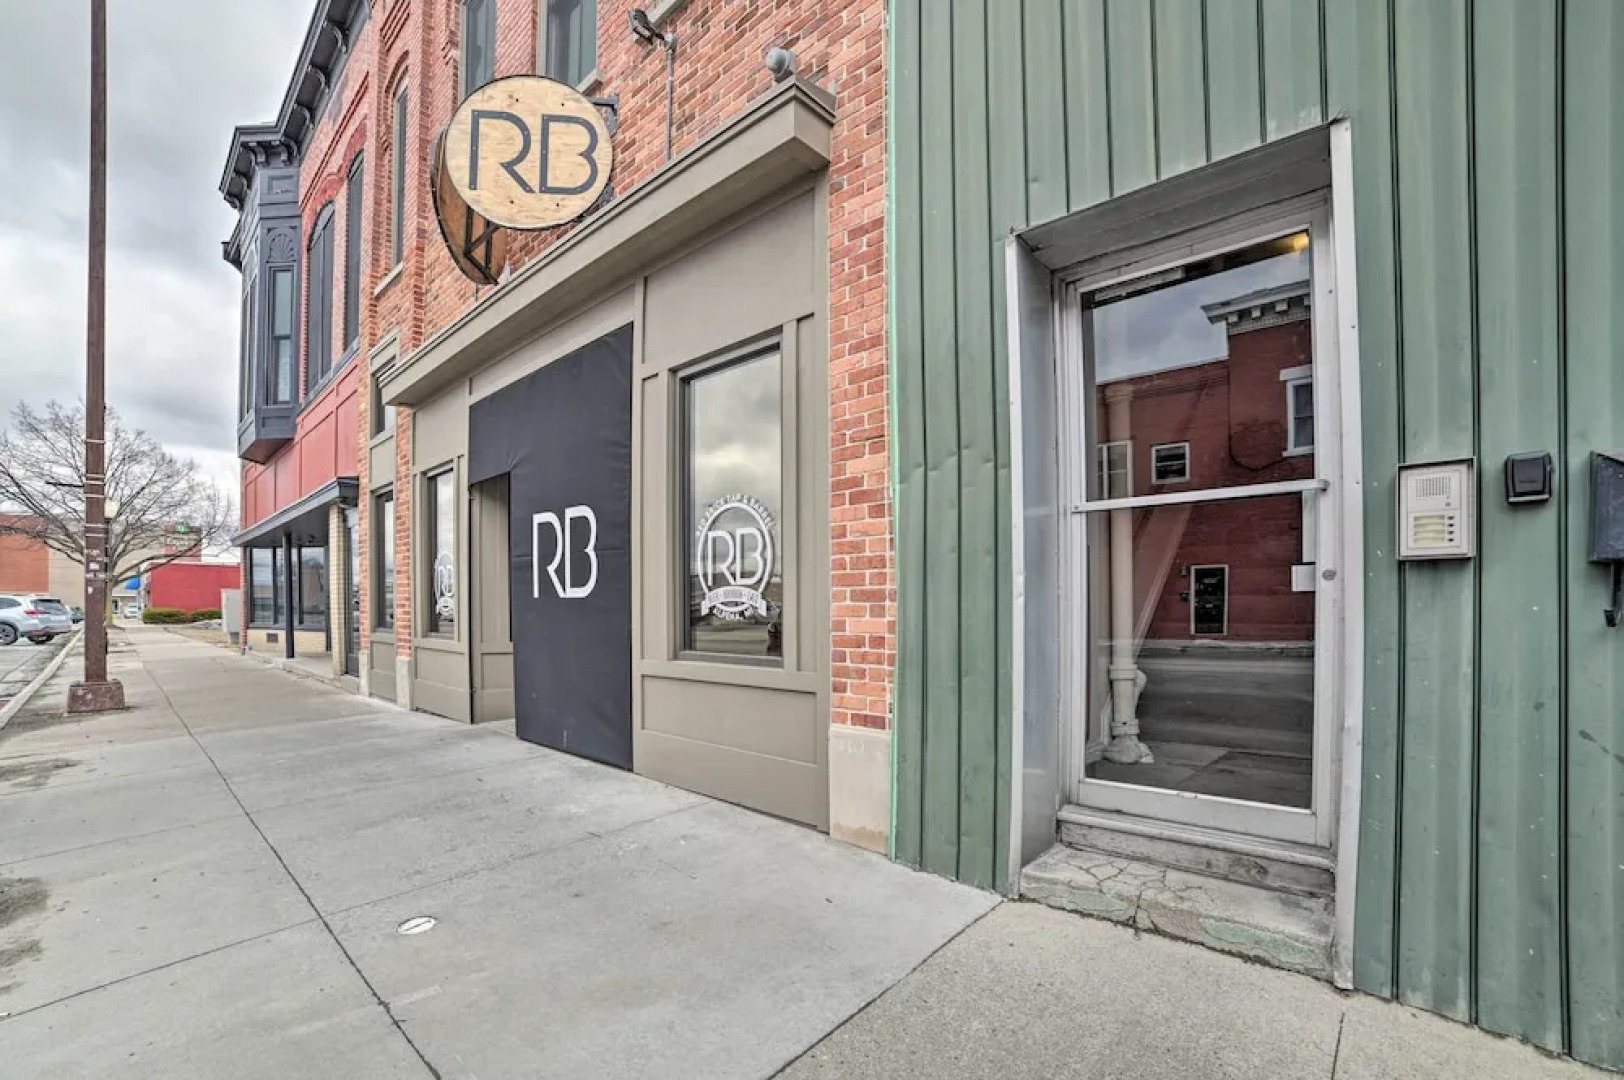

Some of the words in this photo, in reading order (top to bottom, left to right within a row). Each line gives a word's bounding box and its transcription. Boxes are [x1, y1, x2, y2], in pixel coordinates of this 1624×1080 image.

[469, 109, 598, 195] RB
[532, 505, 598, 598] RB
[708, 528, 764, 586] RB
